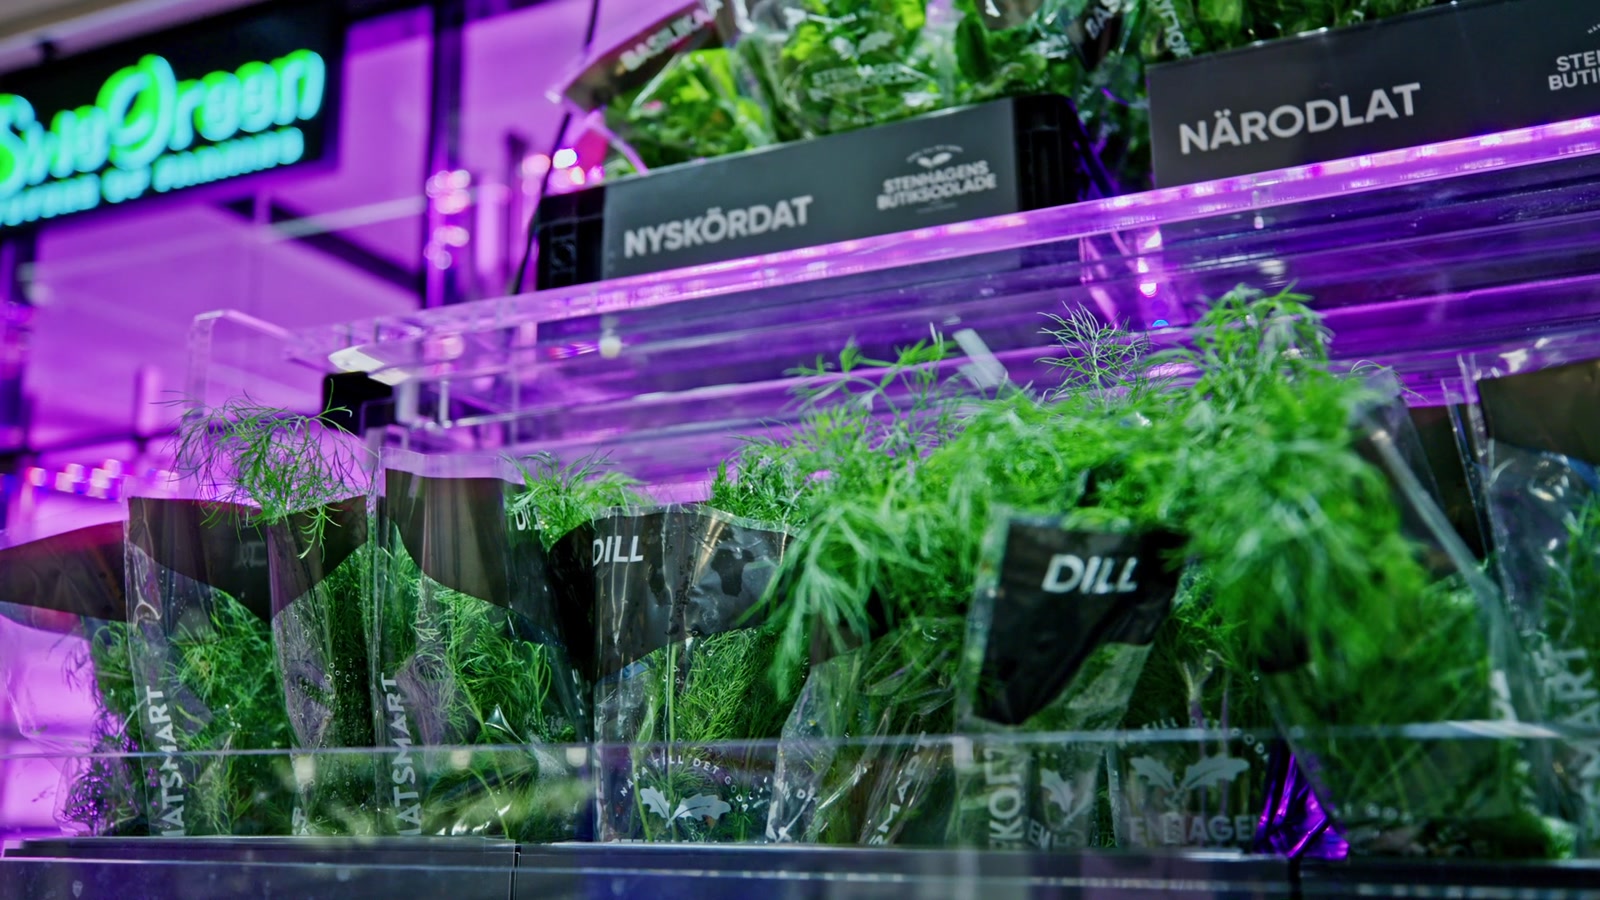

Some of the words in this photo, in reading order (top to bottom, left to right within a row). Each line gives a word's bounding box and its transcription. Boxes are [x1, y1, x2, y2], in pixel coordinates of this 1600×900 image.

[1548, 67, 1600, 91] BUTI
[1179, 83, 1420, 155] NÄRODLAT
[883, 159, 989, 194] STENHAGENS
[624, 195, 813, 258] NYSKÖRDAT
[592, 535, 644, 567] DILL
[1041, 553, 1138, 595] DILL
[693, 757, 720, 775] DET
